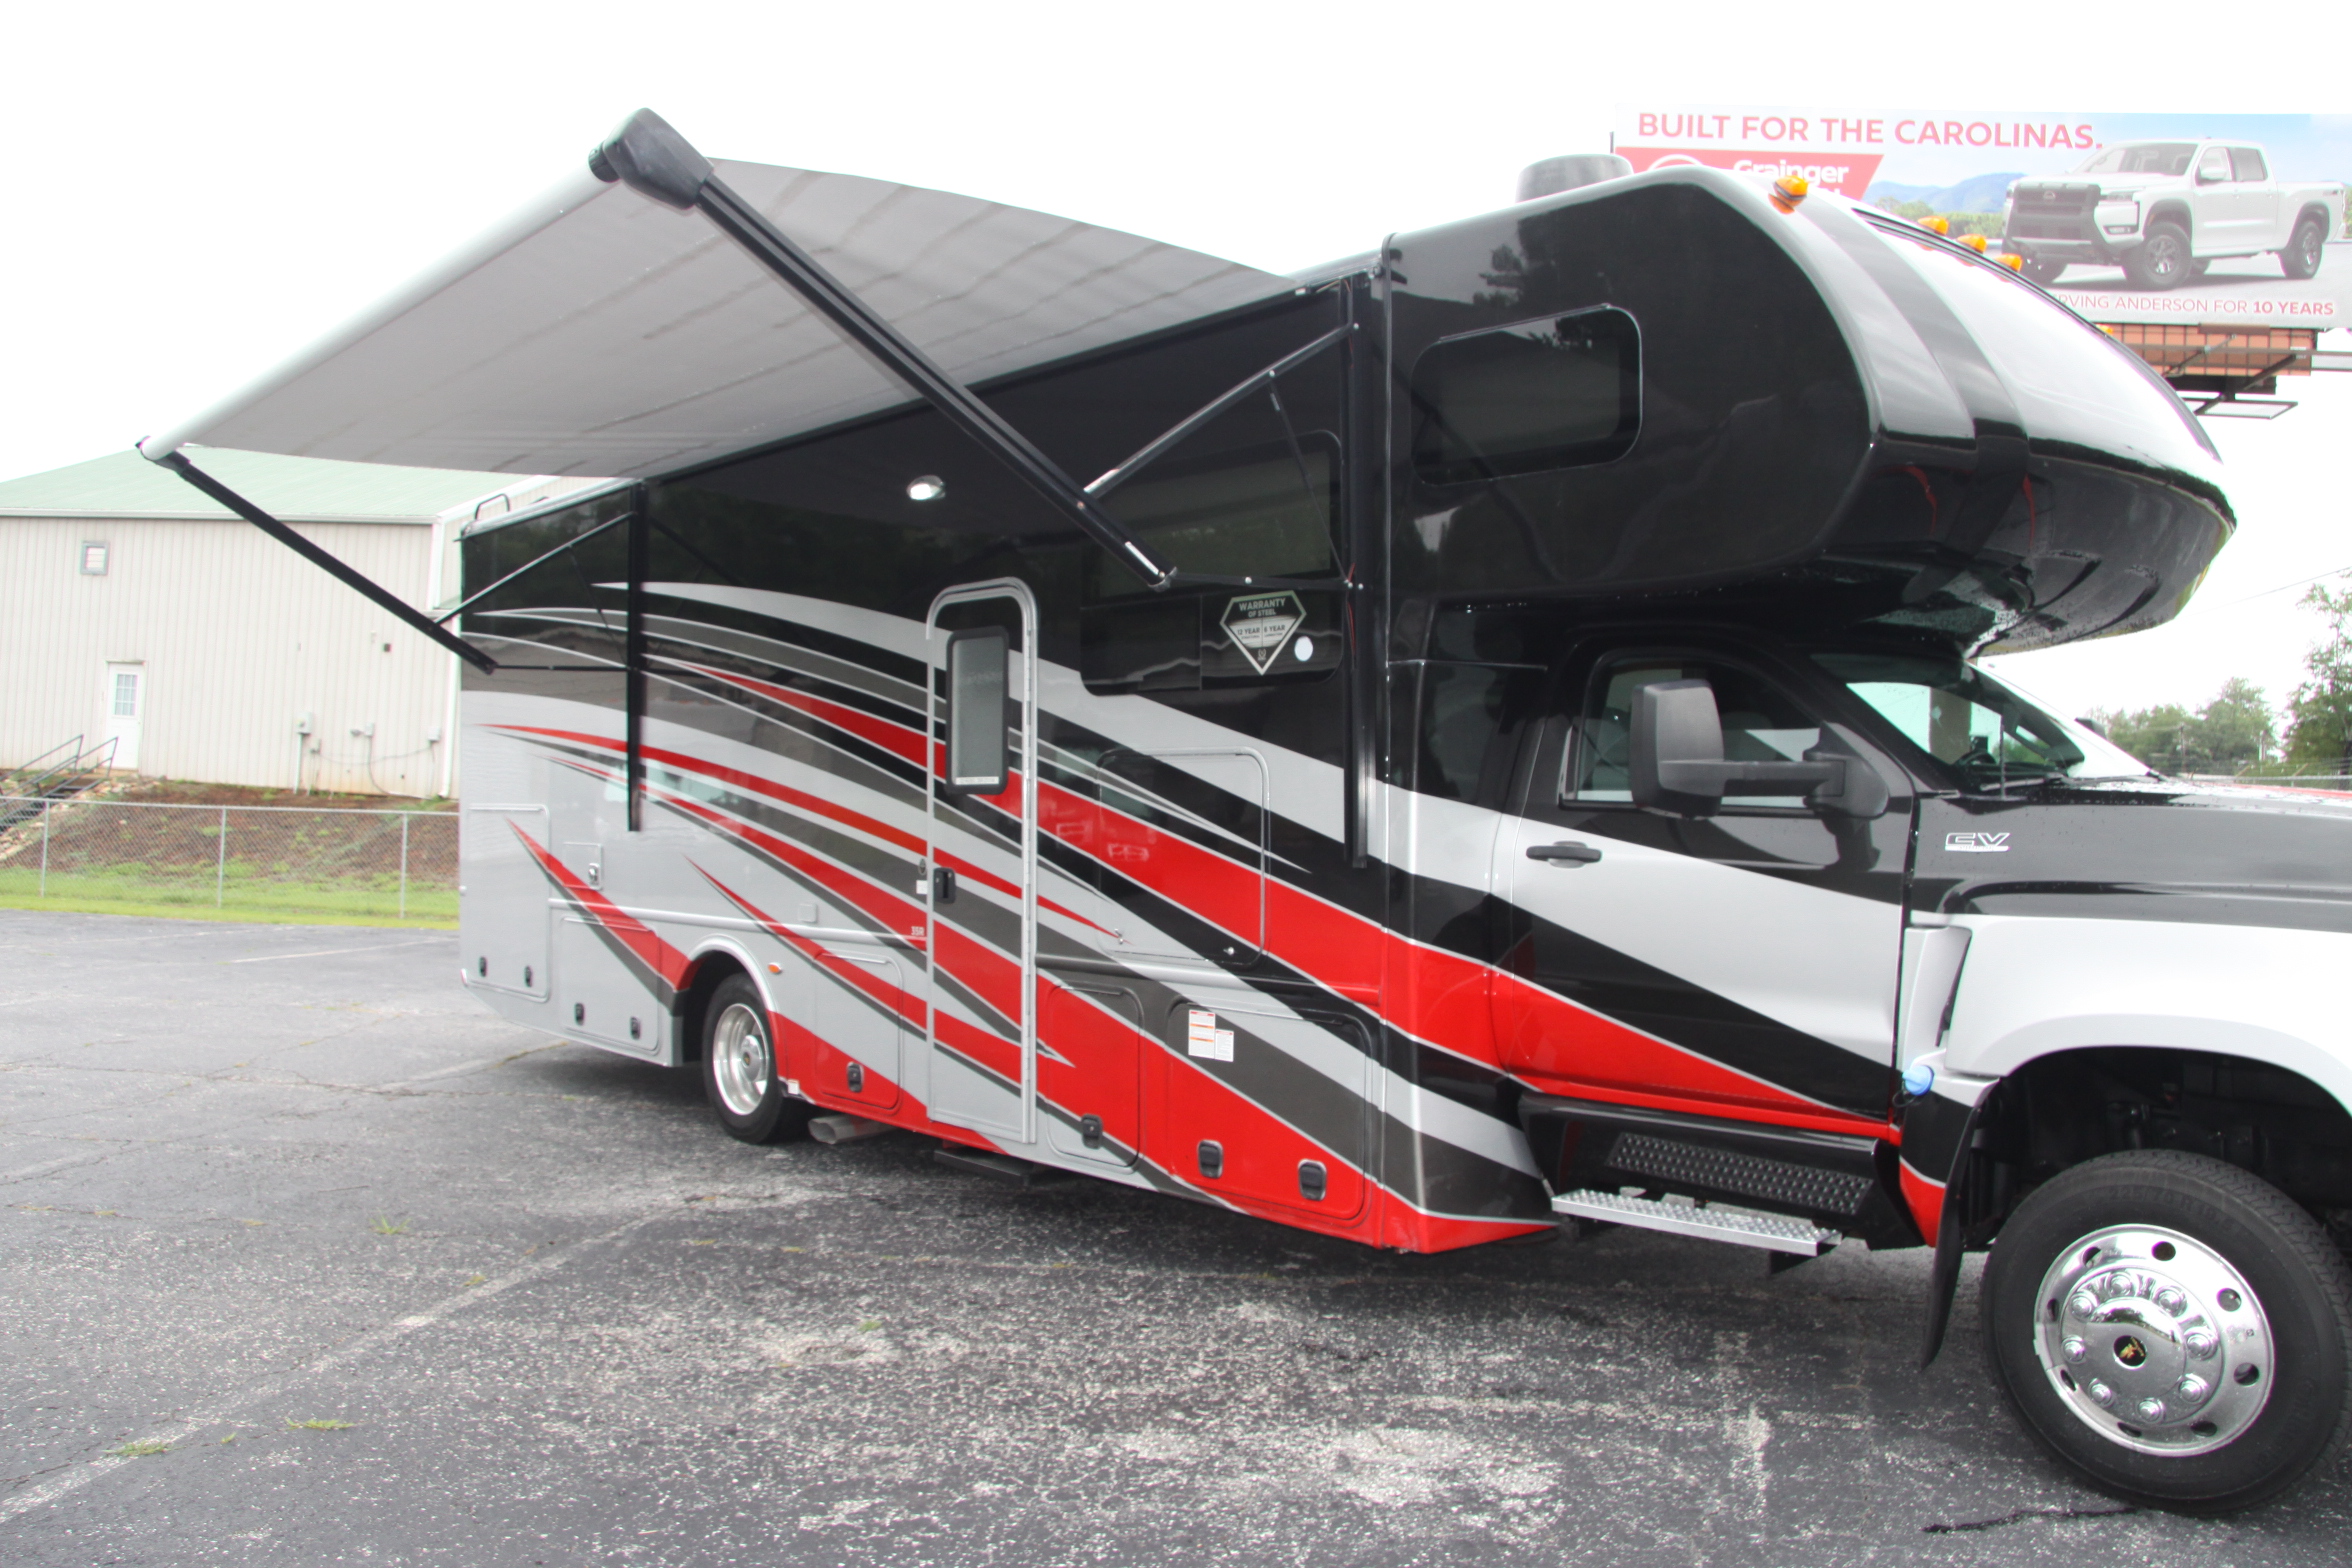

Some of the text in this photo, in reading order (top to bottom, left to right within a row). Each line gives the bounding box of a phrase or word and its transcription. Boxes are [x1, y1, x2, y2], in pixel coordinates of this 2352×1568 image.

[1638, 112, 2104, 150] BUILT FOR THE CAROLINAS.
[2114, 296, 2209, 312] ANDERSON
[2213, 298, 2247, 314] FOR
[2252, 300, 2273, 315] 10
[2277, 300, 2335, 316] YEARS
[1239, 598, 1286, 611] WARRANTY
[1248, 608, 1276, 618] OF STEEL
